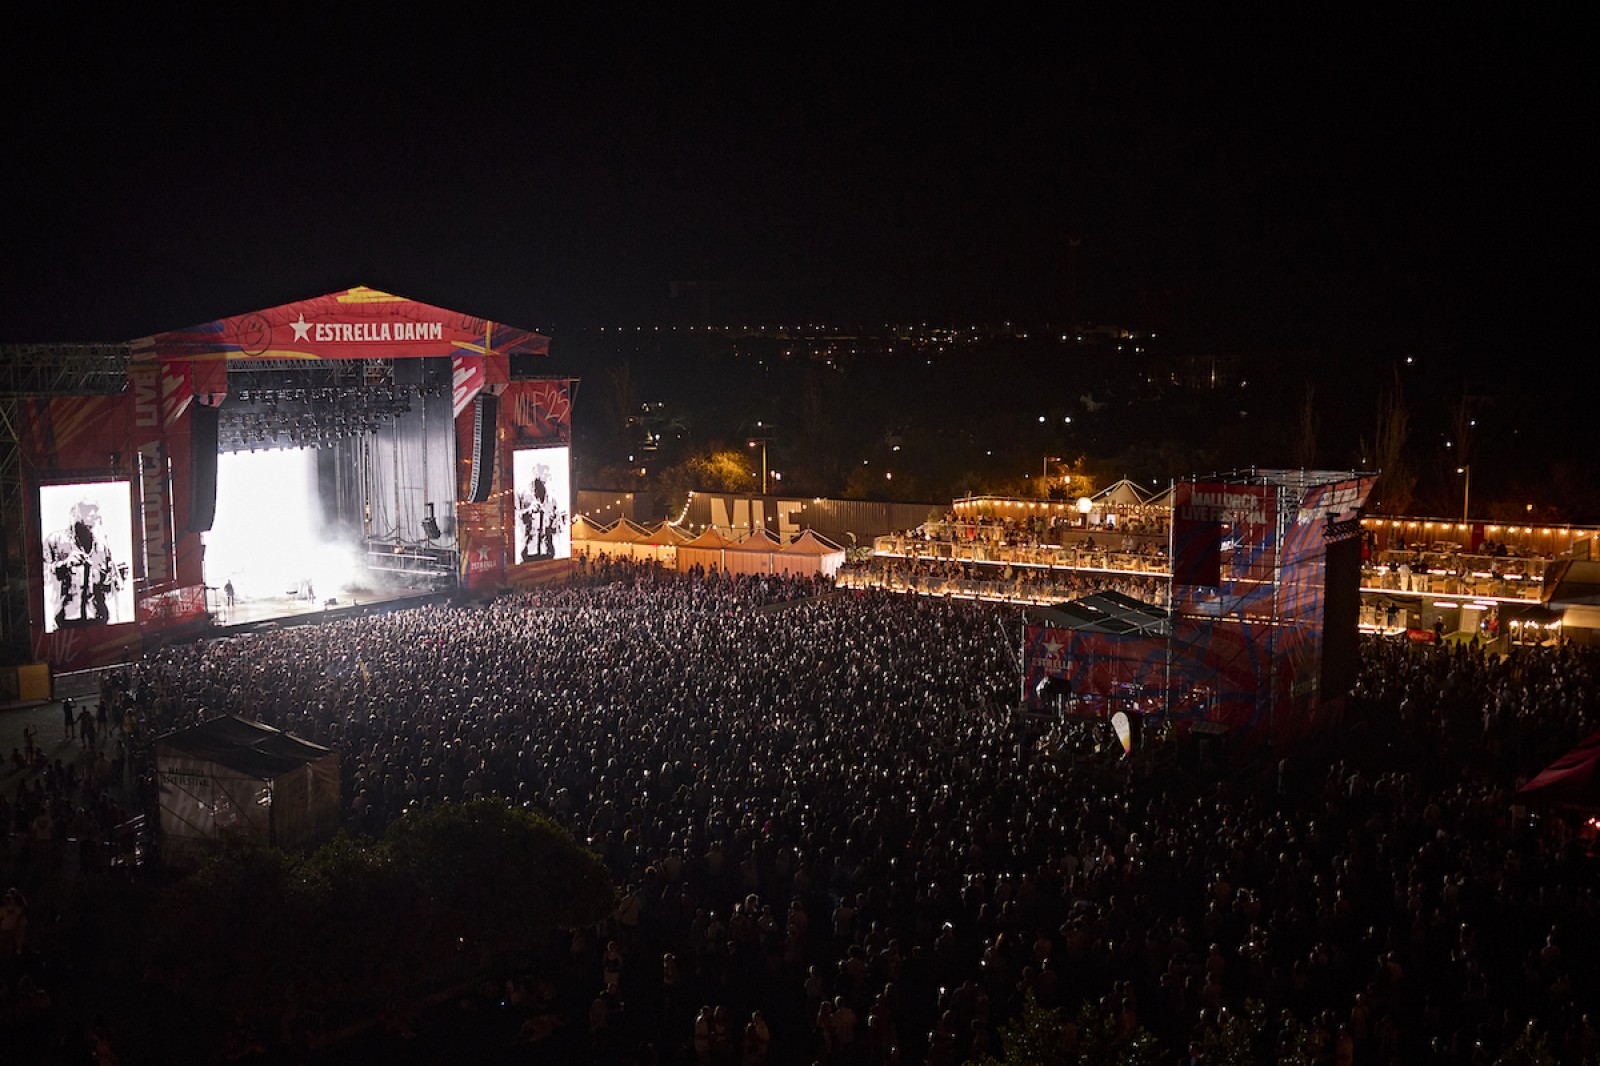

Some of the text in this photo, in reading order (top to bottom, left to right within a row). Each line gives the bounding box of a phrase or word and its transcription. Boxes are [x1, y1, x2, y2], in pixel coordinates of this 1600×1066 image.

[315, 322, 443, 342] ESTRELLA DAMM
[136, 371, 158, 426] LIVE
[1190, 492, 1260, 509] MALLORCA
[1181, 505, 1209, 521] LIVE
